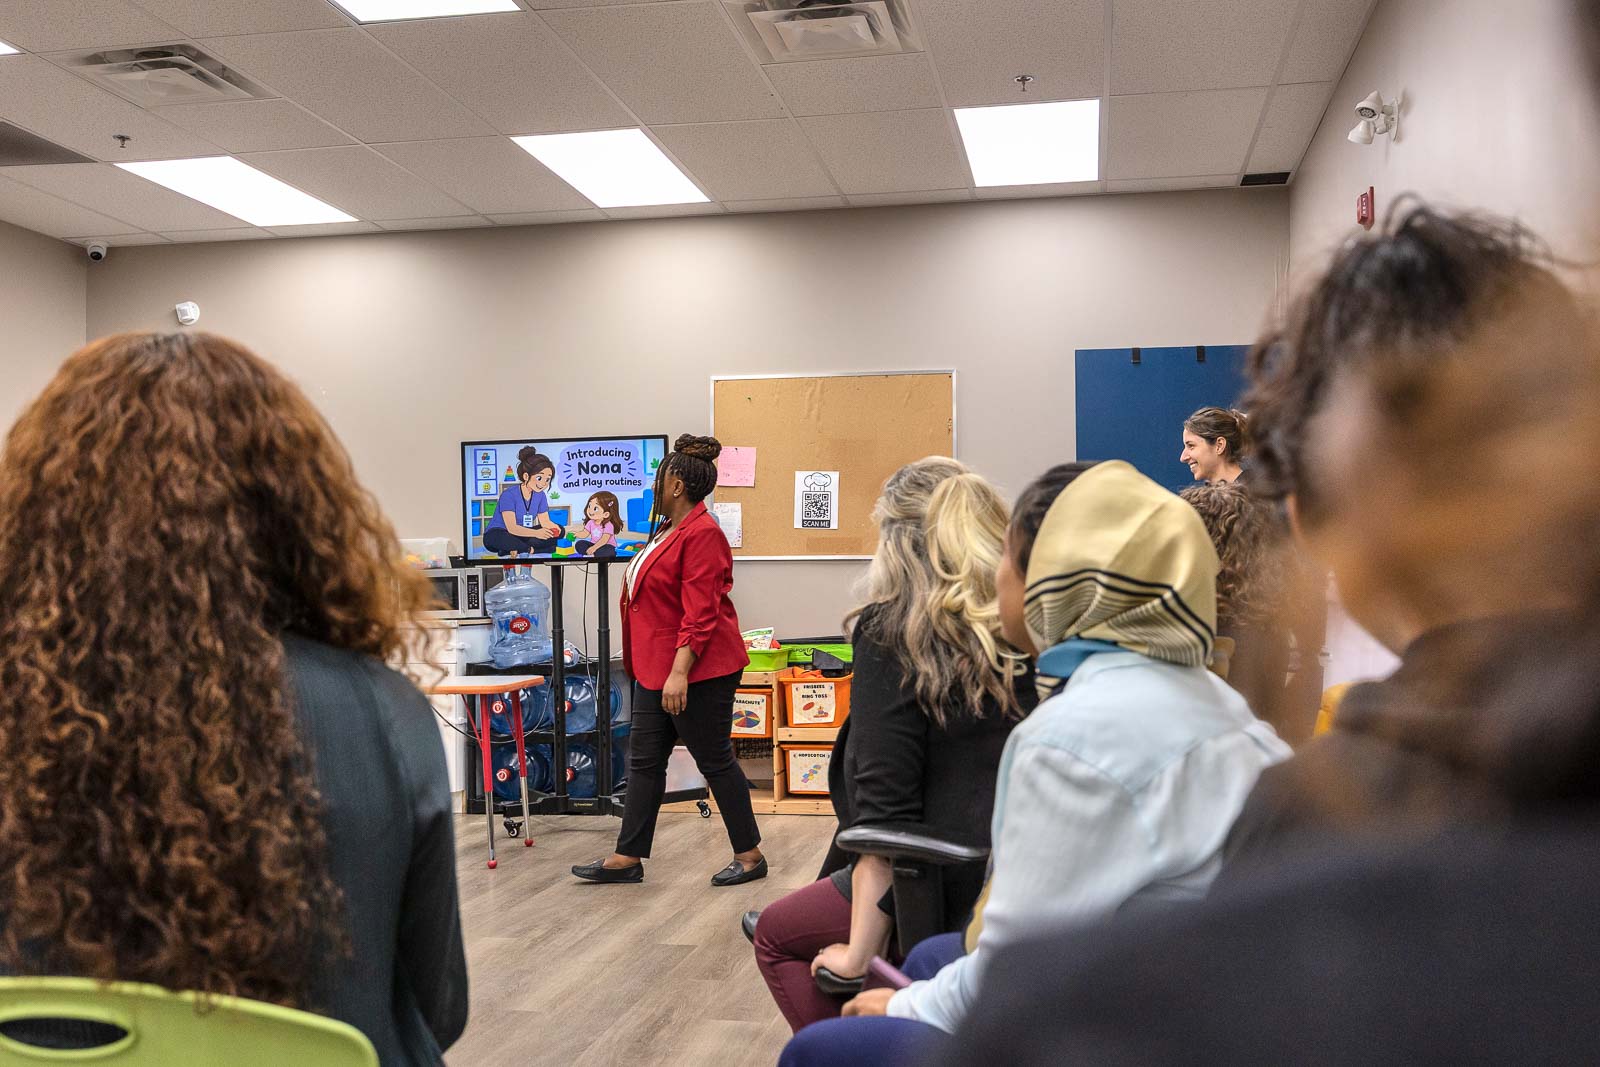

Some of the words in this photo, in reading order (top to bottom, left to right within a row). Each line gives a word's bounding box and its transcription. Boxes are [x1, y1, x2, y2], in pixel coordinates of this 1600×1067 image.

[566, 446, 631, 461] Introducing
[577, 461, 622, 476] Nona
[563, 479, 580, 488] and
[582, 478, 602, 488] Play
[605, 477, 642, 486] routines
